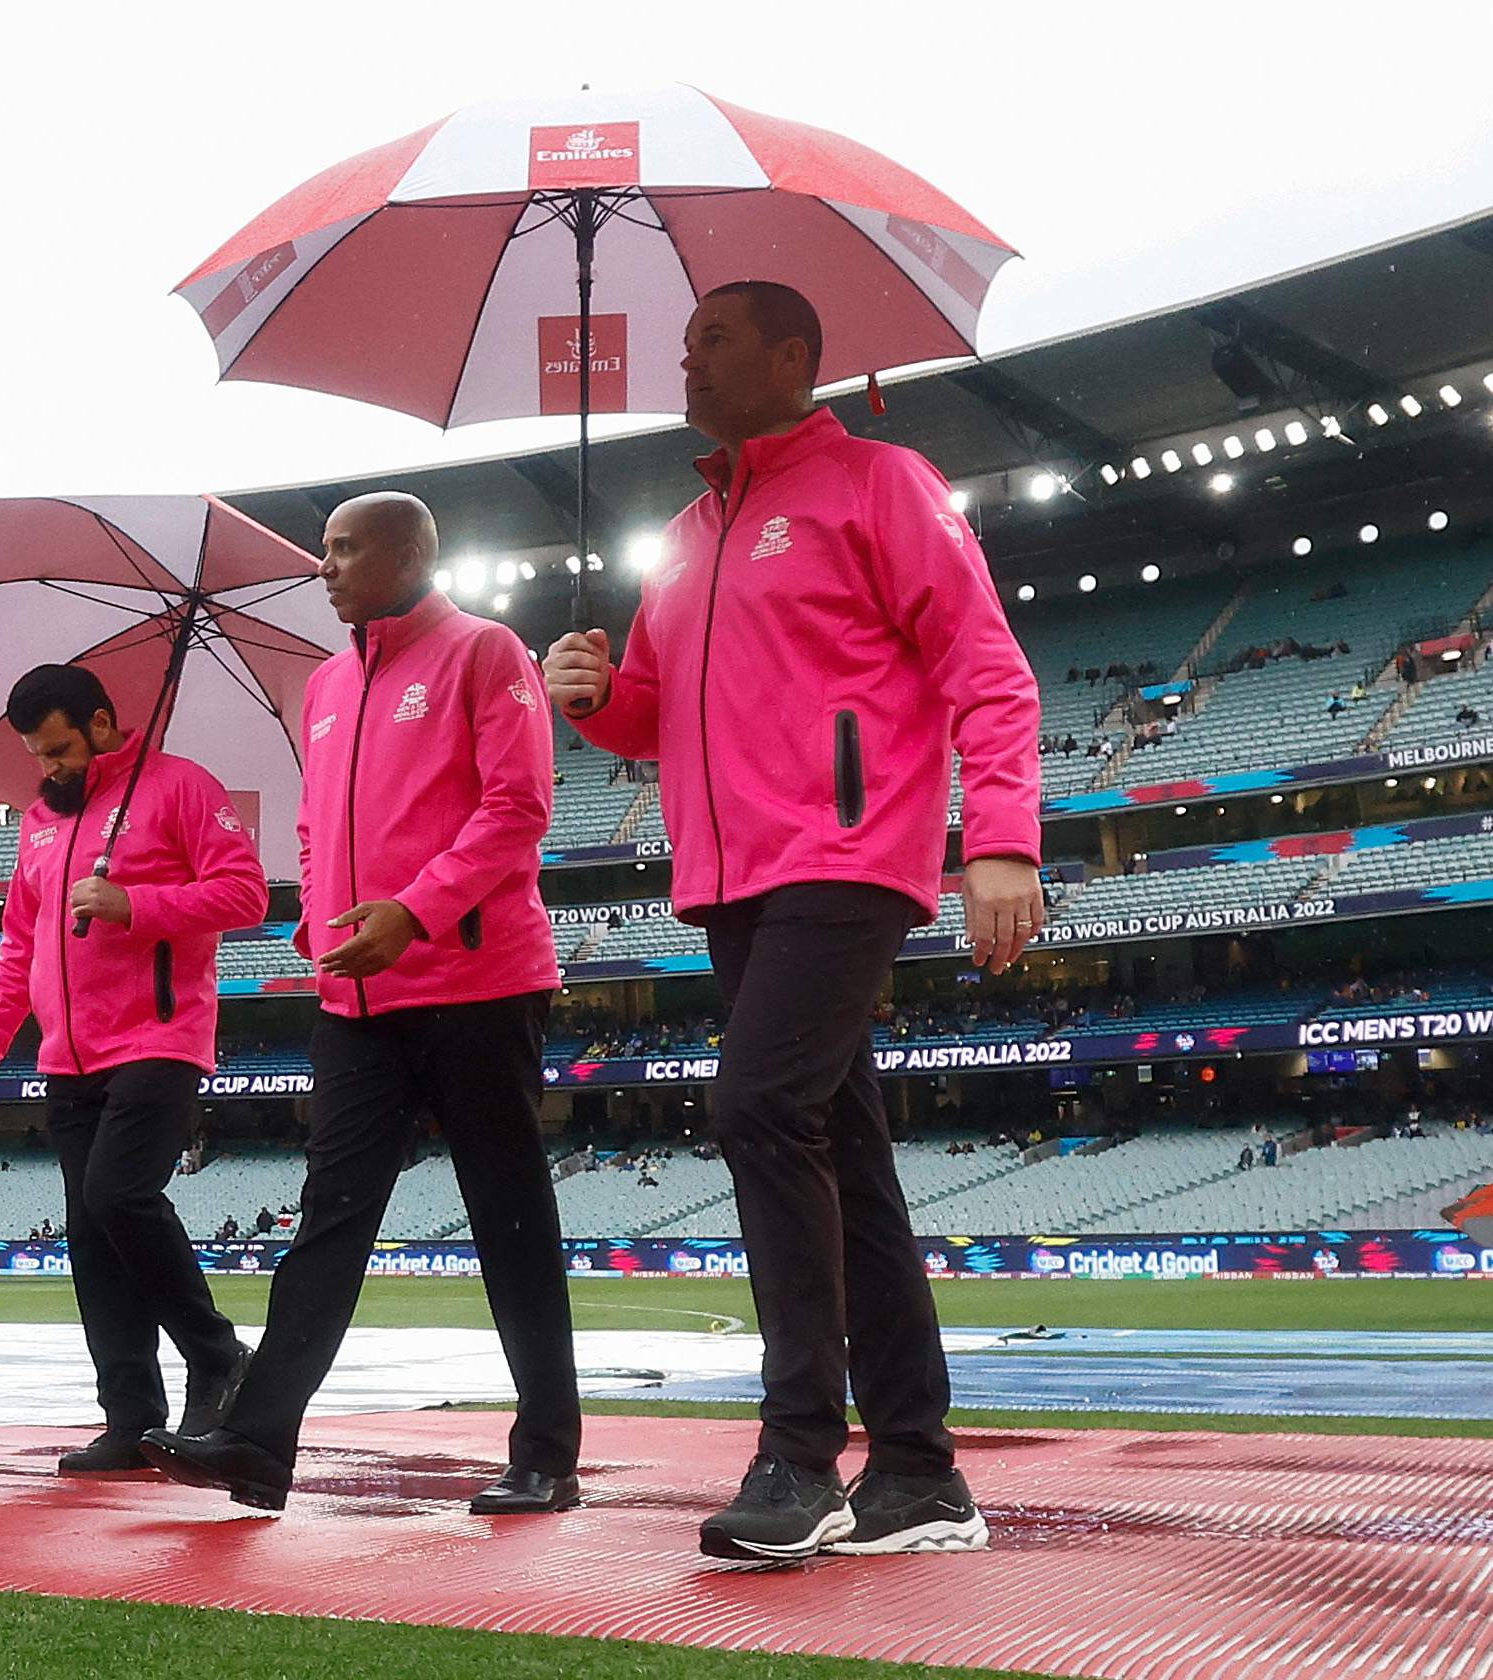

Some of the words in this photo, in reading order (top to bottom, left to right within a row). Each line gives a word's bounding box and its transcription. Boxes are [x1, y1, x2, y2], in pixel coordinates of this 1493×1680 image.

[536, 146, 634, 162] Emirates
[1388, 738, 1493, 768] MELBOURNE
[637, 842, 661, 856] ICC
[548, 909, 578, 924] T20
[647, 901, 672, 918] CU
[1041, 926, 1072, 943] T20
[1073, 917, 1142, 939] WORLD
[1145, 914, 1184, 932] CUP
[1186, 904, 1290, 929] AUSTRALIA
[1293, 900, 1335, 918] 2022
[1299, 1021, 1340, 1046] ICC
[1341, 1015, 1416, 1043] MEN'S
[1419, 1013, 1463, 1037] T20
[873, 1051, 905, 1070] UP
[907, 1044, 1022, 1069] AUSTRALIA
[1025, 1041, 1072, 1063] 2022
[645, 1061, 680, 1080] ICC
[211, 1076, 249, 1094] CUP
[1212, 1272, 1253, 1280] NISSAN
[1273, 1272, 1315, 1280] NISSAN
